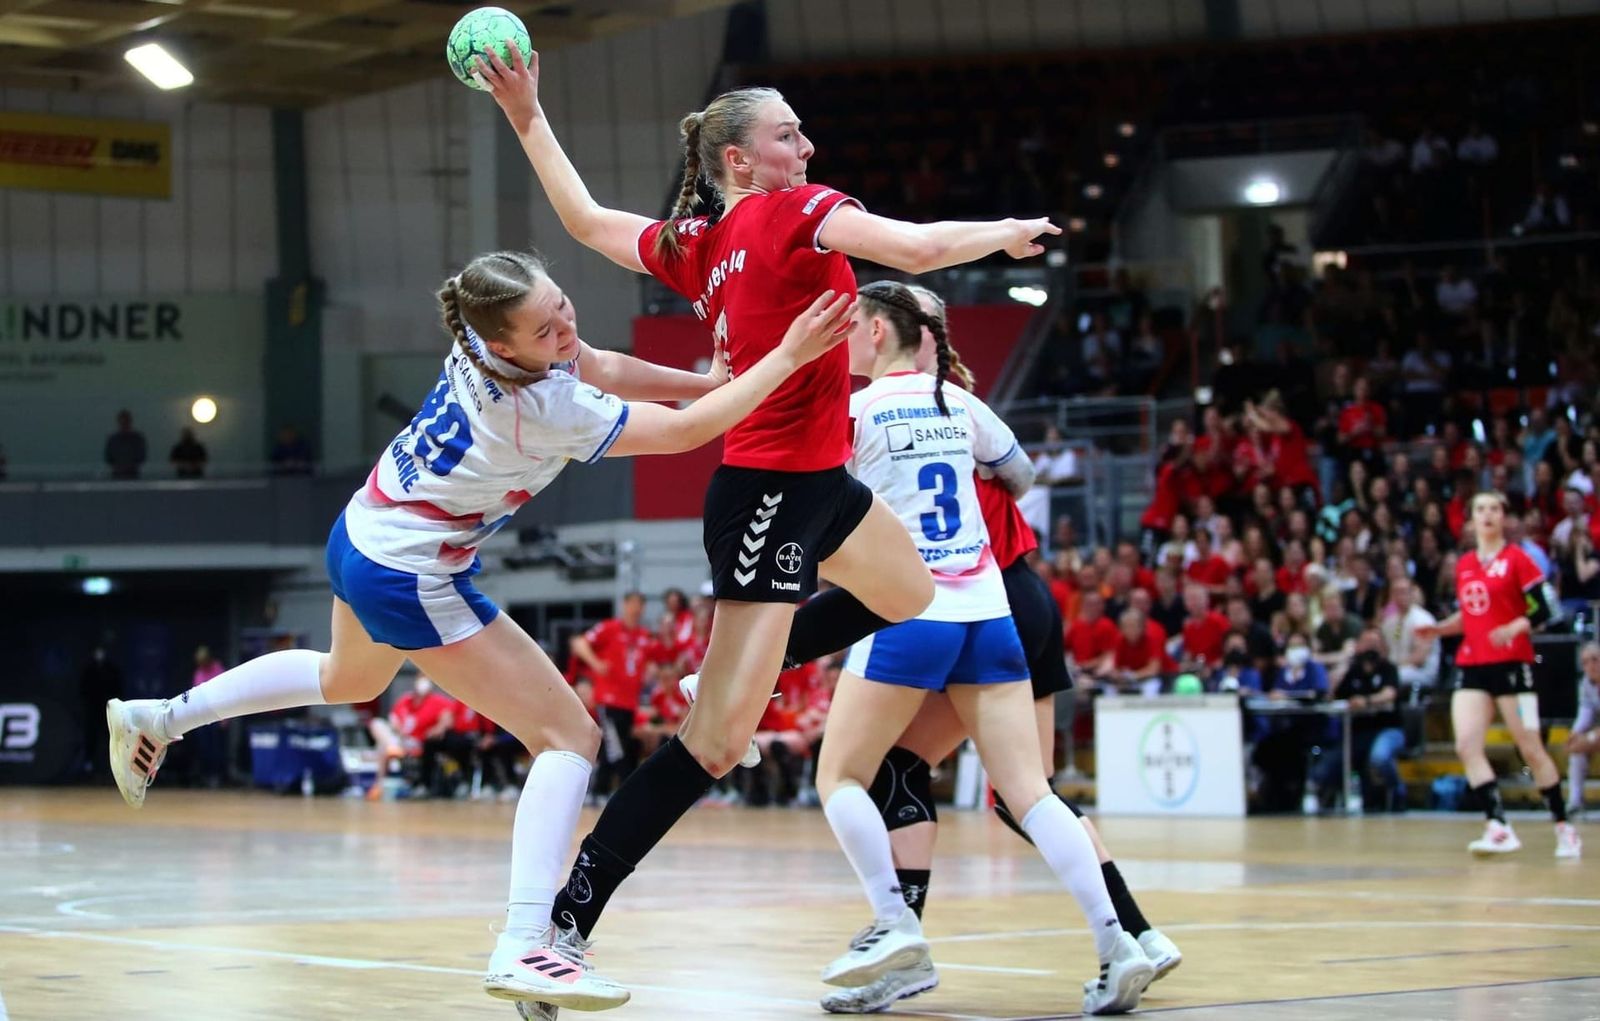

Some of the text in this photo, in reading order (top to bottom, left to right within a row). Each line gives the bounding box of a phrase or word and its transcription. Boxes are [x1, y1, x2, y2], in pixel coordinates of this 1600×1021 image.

[0, 303, 182, 341] INDNER
[873, 410, 896, 425] HSG
[915, 427, 968, 442] SANDER
[918, 462, 961, 542] 3
